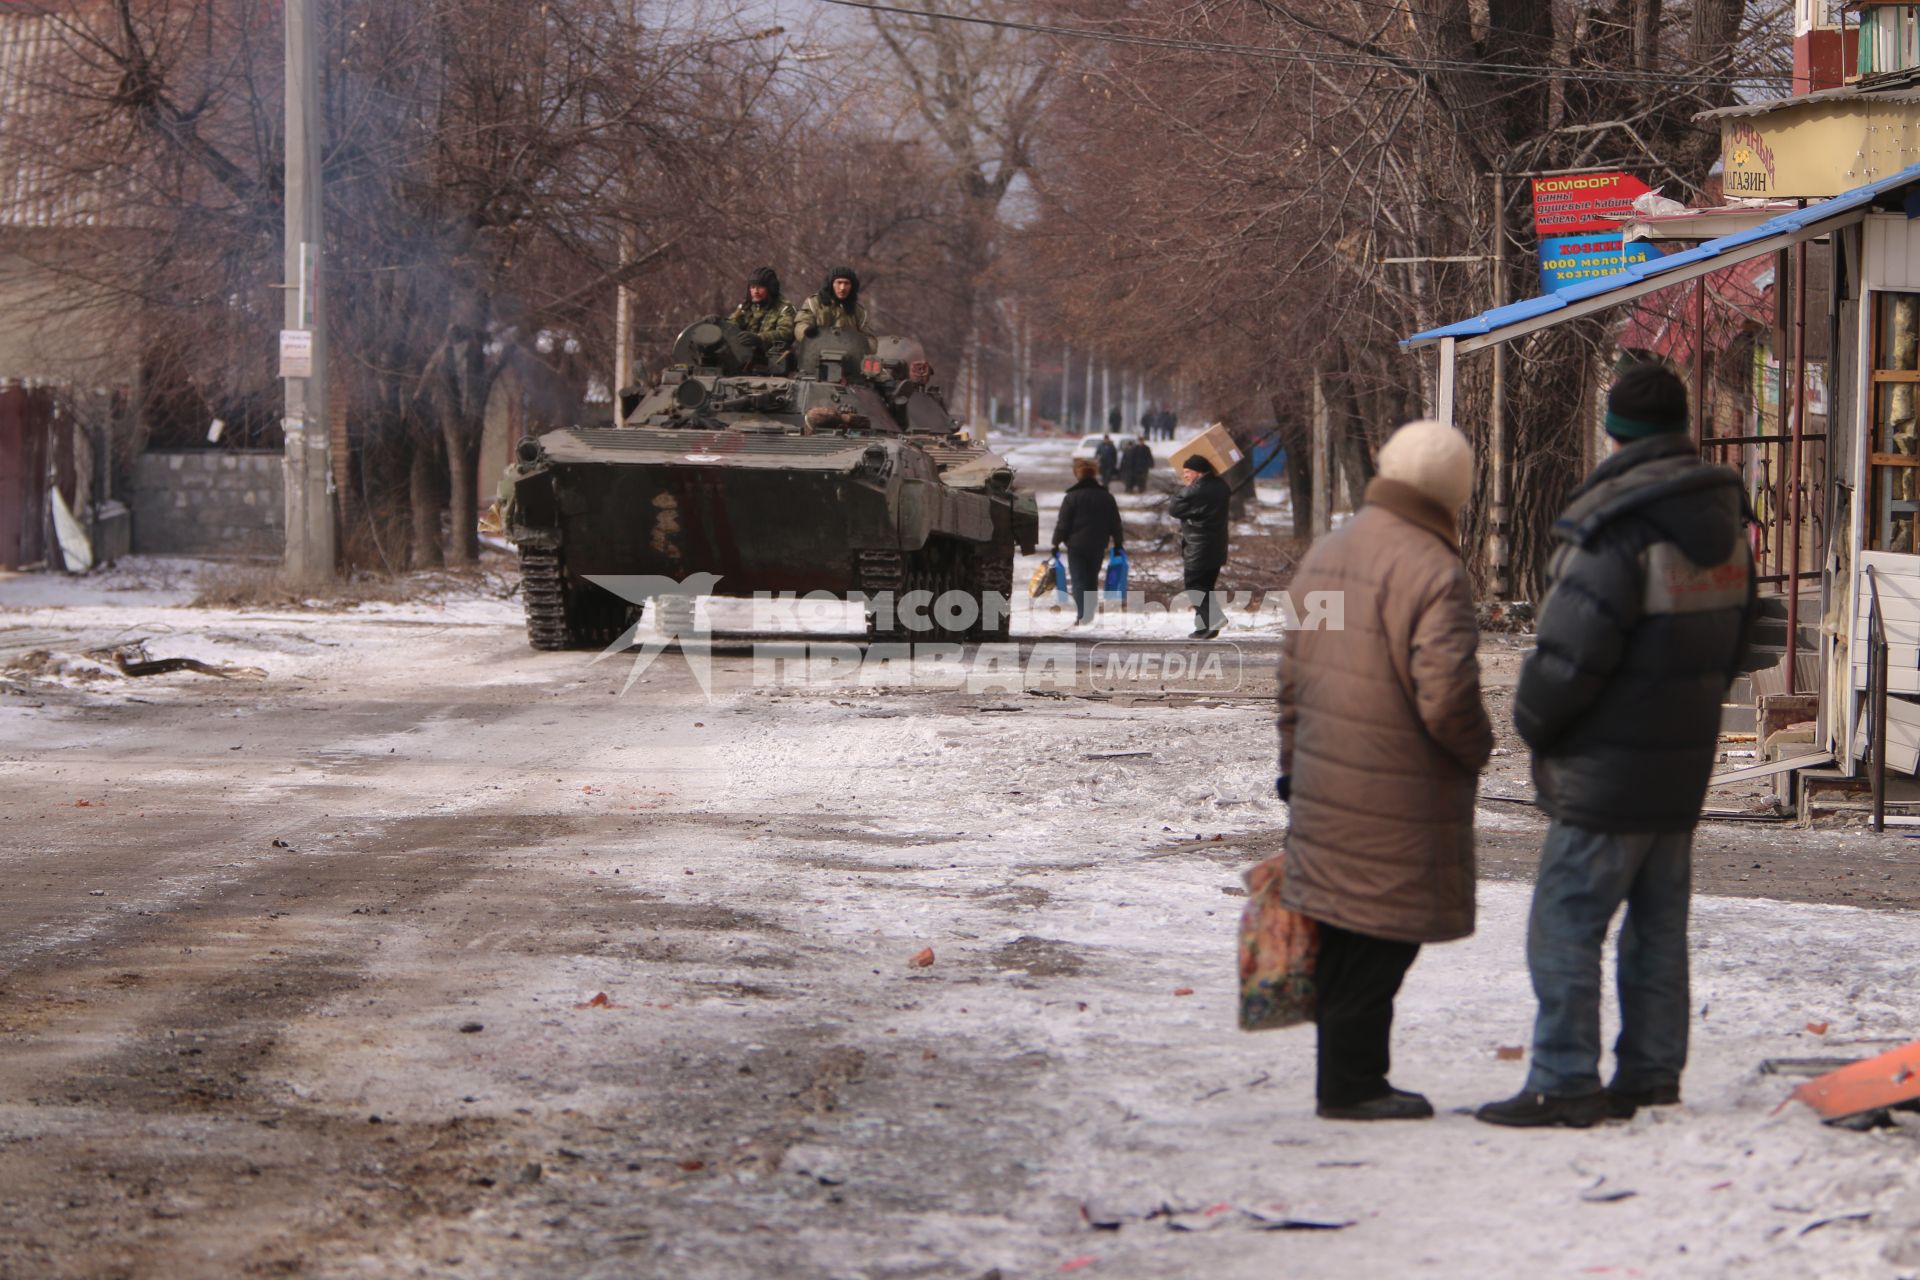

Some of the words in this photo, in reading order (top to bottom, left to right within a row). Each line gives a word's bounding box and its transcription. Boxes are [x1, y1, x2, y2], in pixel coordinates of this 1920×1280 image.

[1535, 176, 1620, 192] КОМФОРТ
[1536, 192, 1573, 203] ванны
[1537, 201, 1591, 214] душевые
[1538, 214, 1577, 225] мебель
[1542, 258, 1577, 270] 1000
